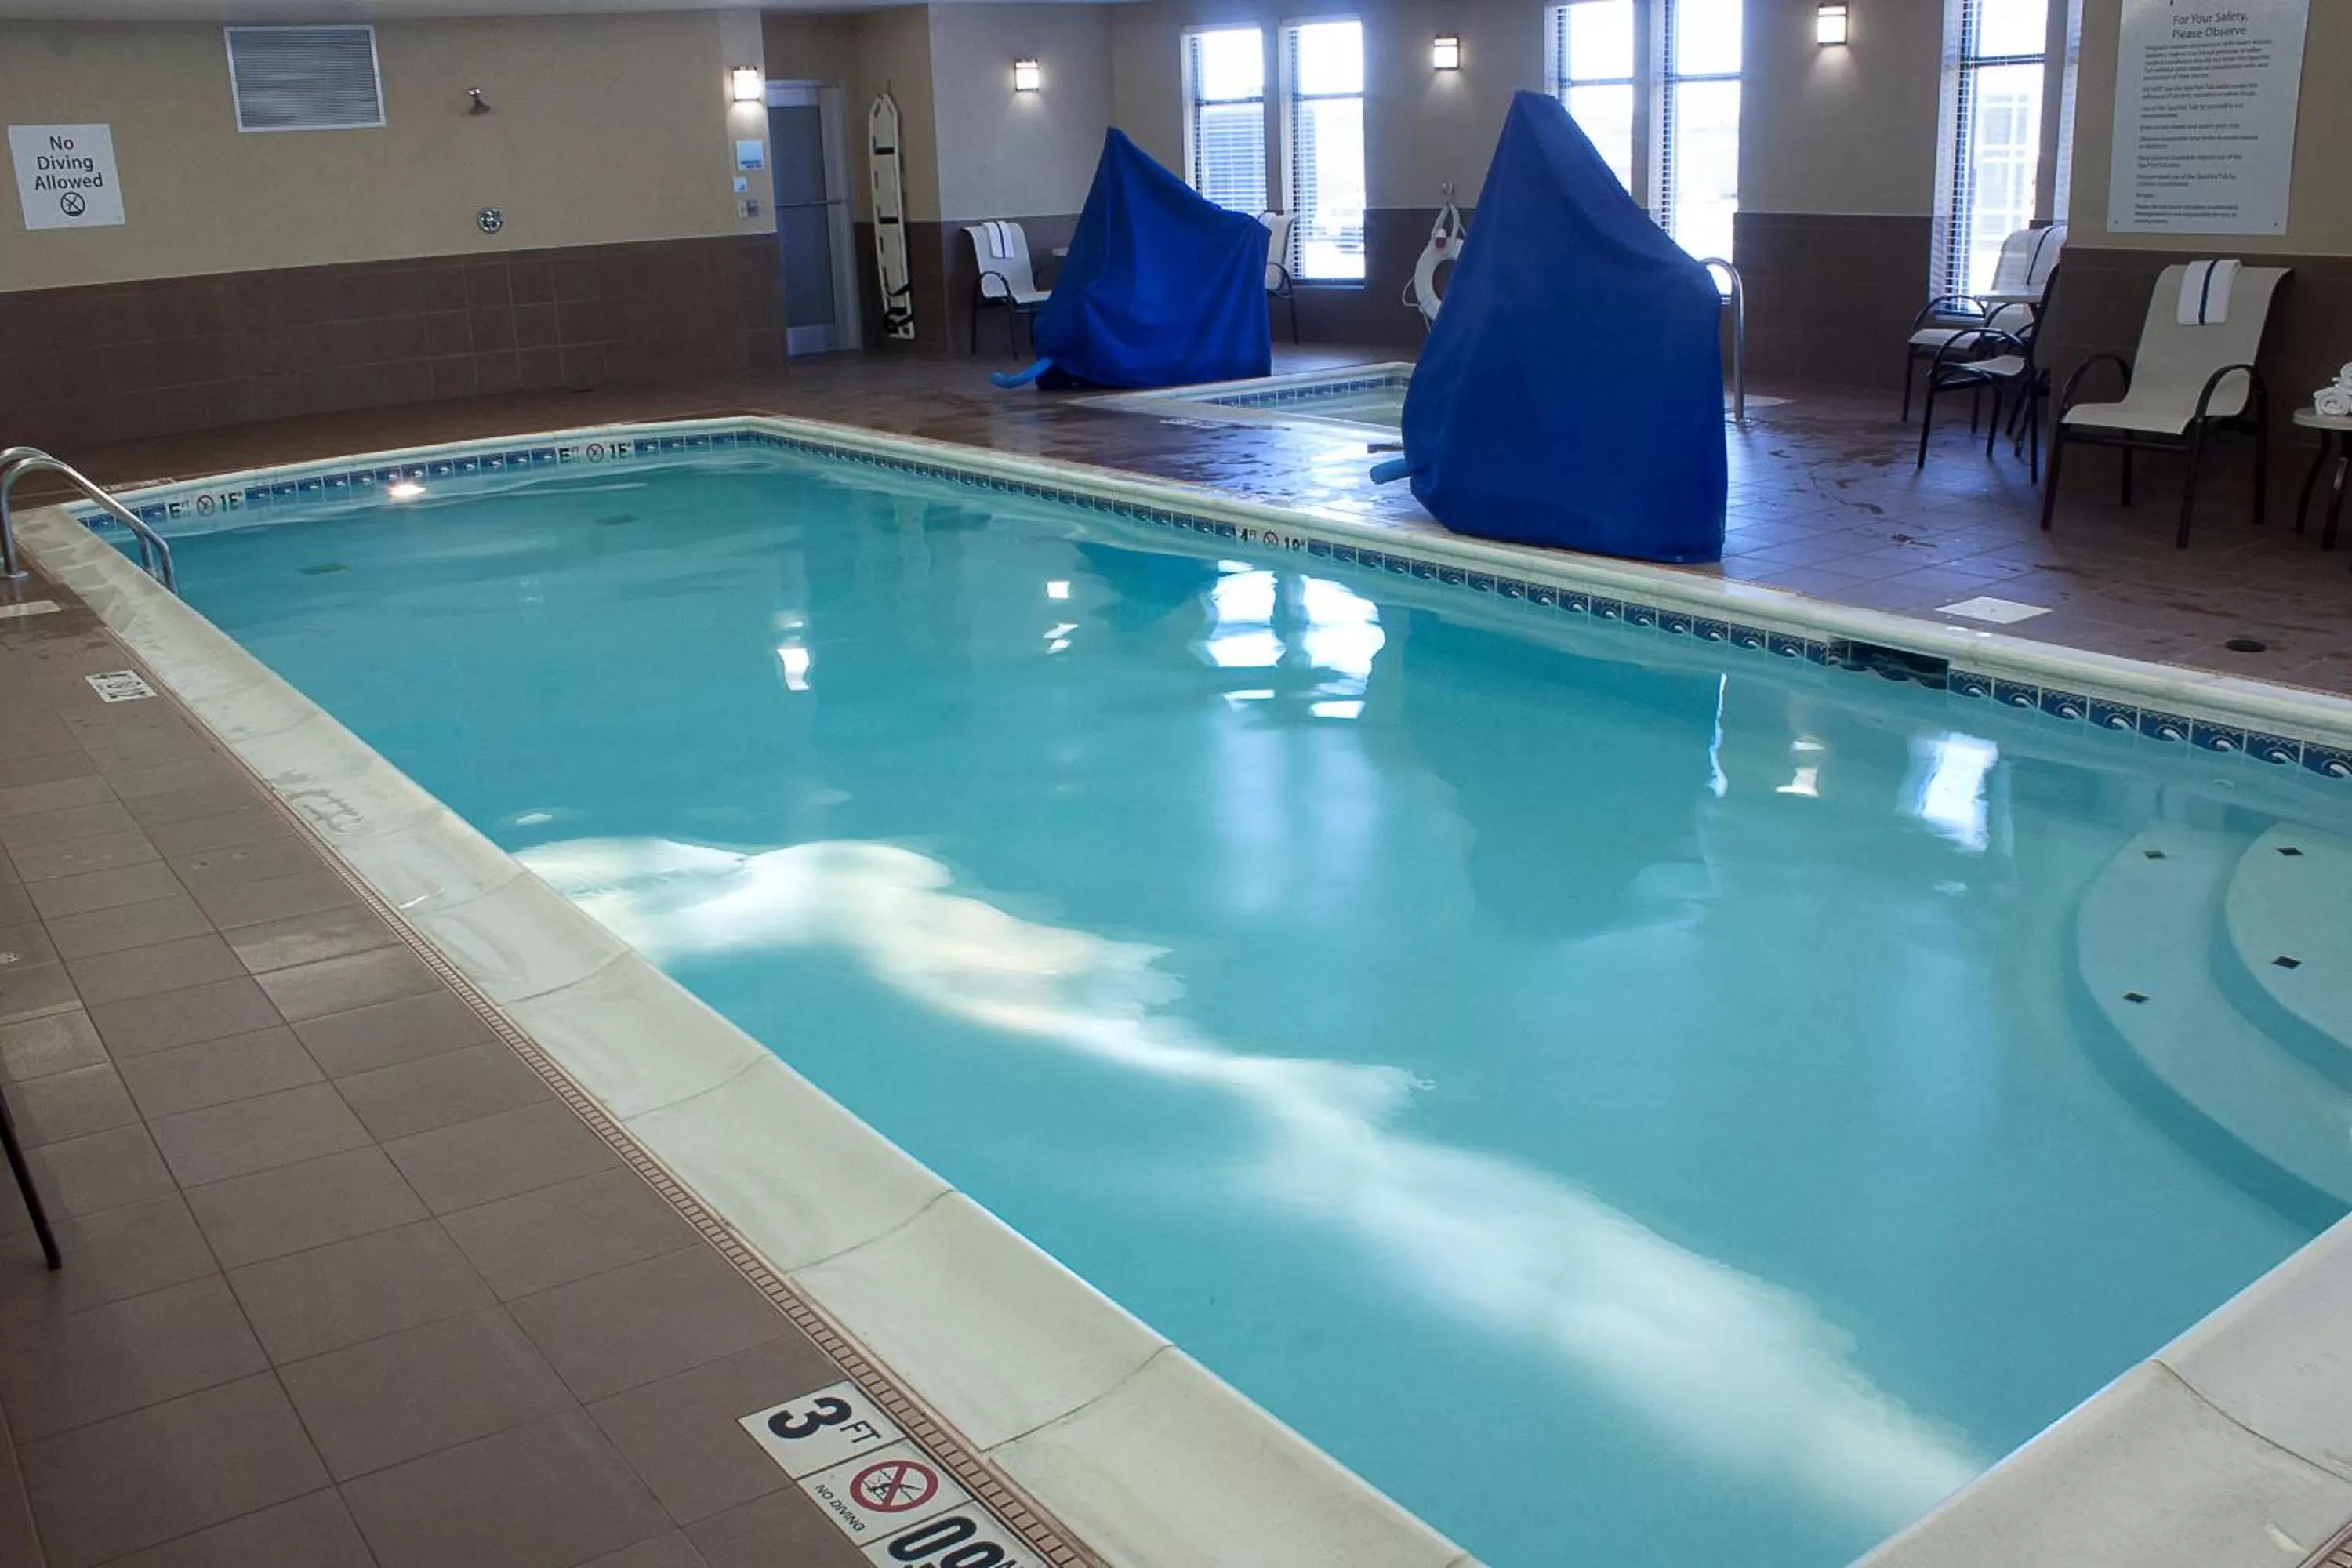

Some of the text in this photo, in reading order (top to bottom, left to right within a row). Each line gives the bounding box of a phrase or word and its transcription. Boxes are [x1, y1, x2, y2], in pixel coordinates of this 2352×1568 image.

[2172, 15, 2190, 26] For
[2191, 13, 2214, 25] Your
[2172, 27, 2247, 39] Please Observe
[49, 136, 74, 151] No
[37, 154, 93, 172] Diving
[34, 172, 103, 191] Allowed
[768, 1396, 882, 1443] 3 FT
[815, 1484, 866, 1531] NO DIVING
